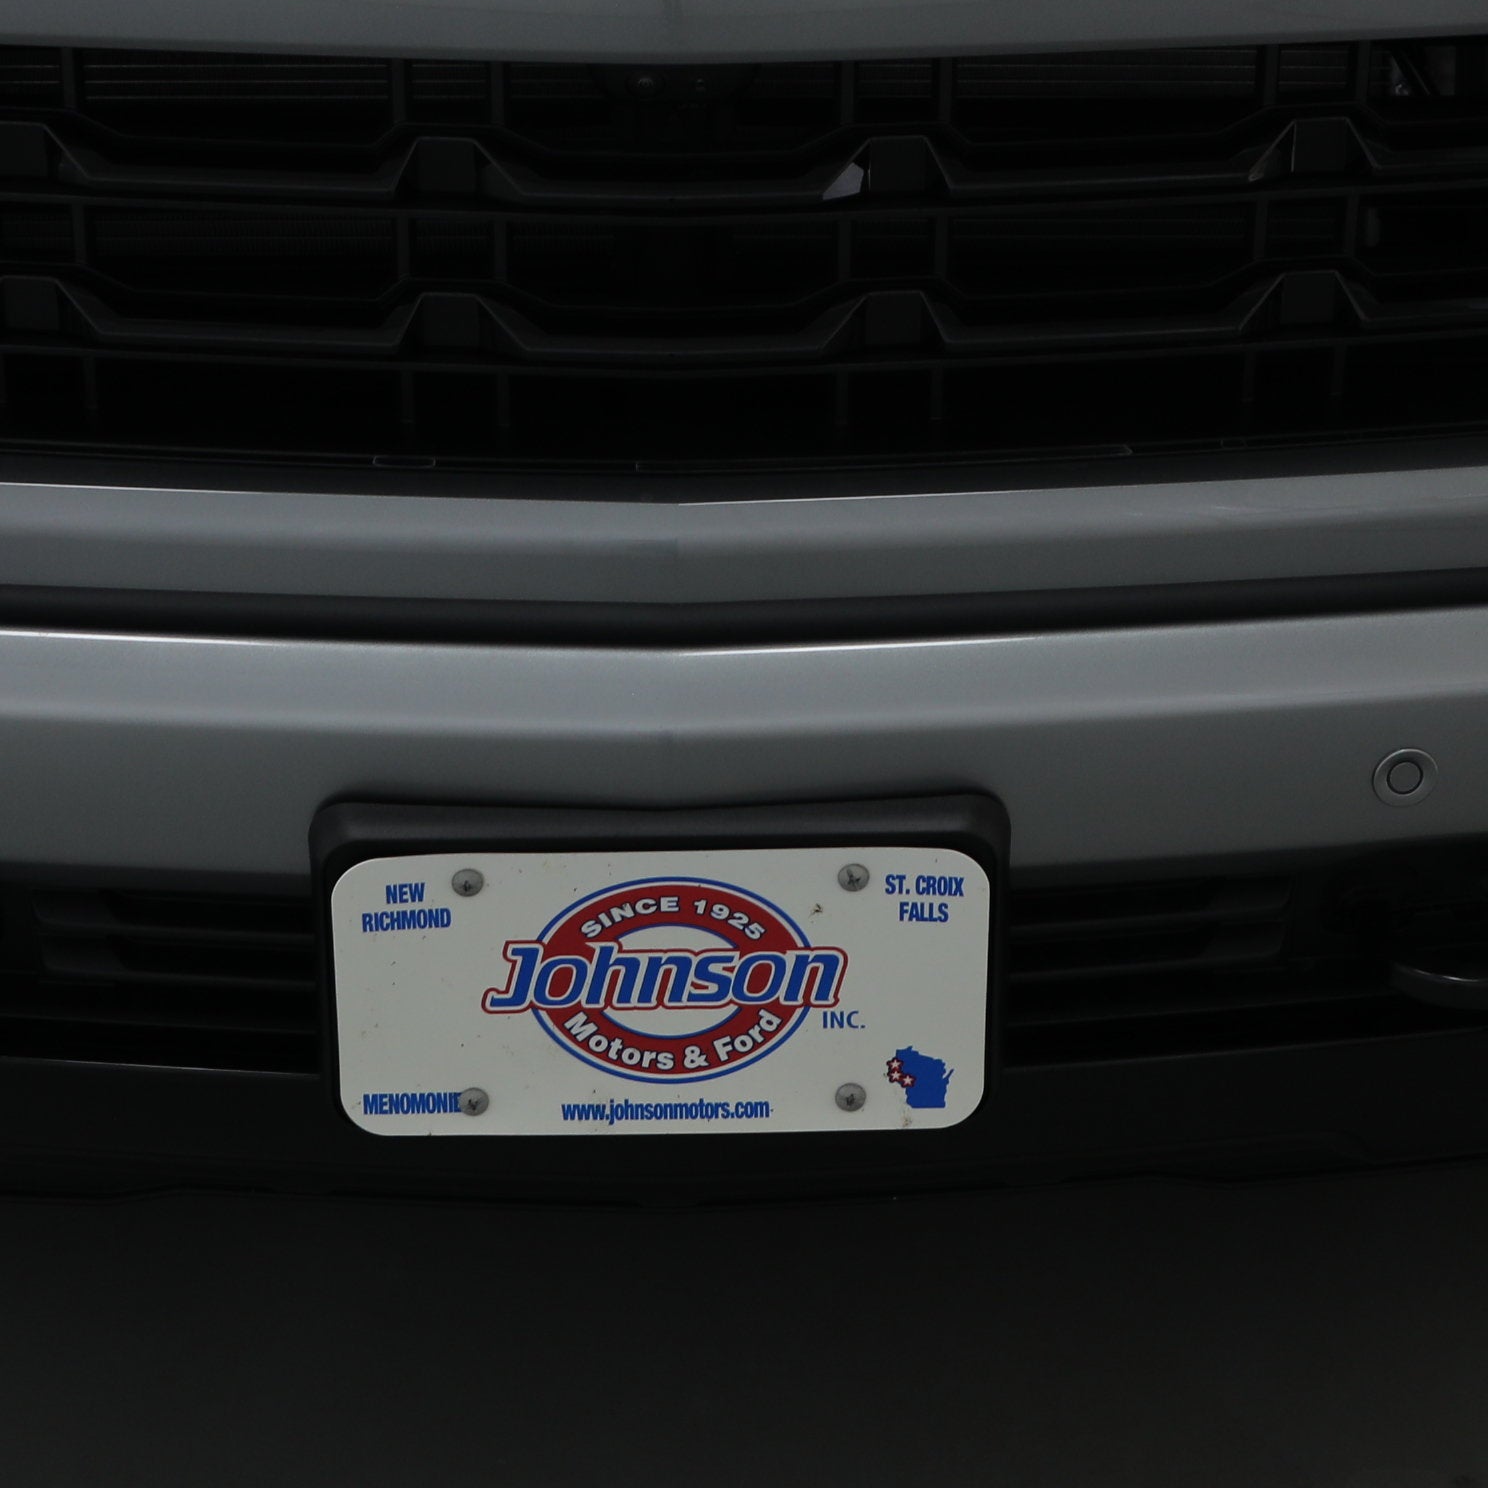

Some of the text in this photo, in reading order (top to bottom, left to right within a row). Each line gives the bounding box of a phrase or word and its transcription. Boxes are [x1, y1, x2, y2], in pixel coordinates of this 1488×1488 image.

[385, 882, 426, 905] NEW
[885, 873, 965, 898] ST. CROIX
[362, 907, 452, 933] RICHMOND
[580, 896, 767, 941] SINCE 1925
[899, 901, 949, 923] FALLS
[488, 944, 842, 1009] Johnson
[821, 1010, 866, 1030] INC.
[563, 1008, 783, 1071] Motors & Ford
[363, 1091, 464, 1115] MENOMONIE
[561, 1097, 771, 1126] www.johnsonmotors.com
